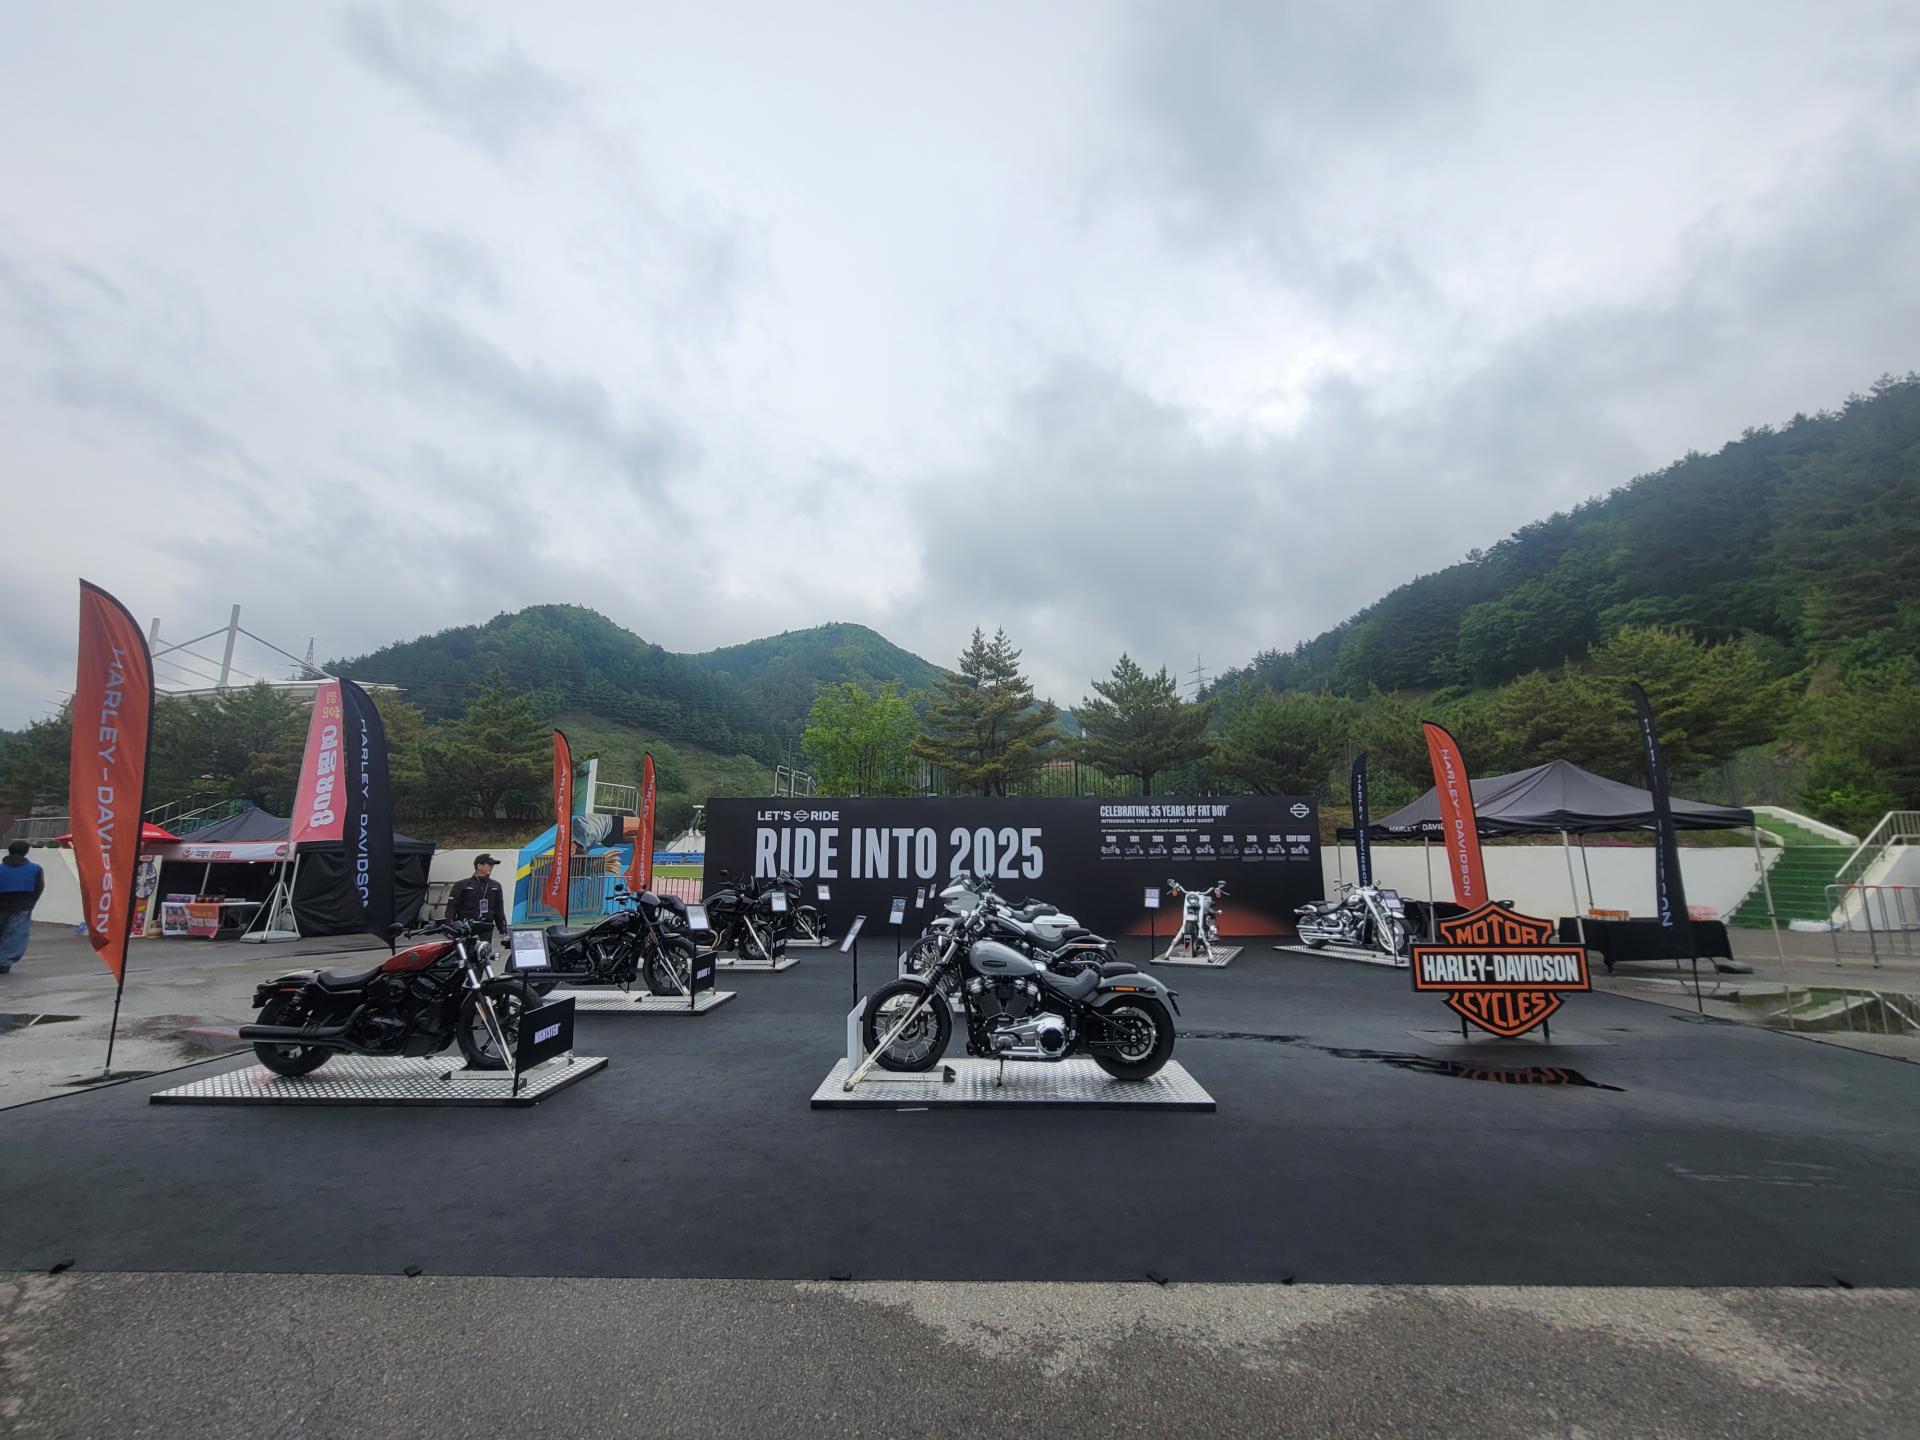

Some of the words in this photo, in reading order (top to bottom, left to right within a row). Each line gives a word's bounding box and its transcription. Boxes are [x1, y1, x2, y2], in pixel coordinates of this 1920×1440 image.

[757, 810, 792, 821] LET'S
[810, 810, 840, 821] RIDE
[1100, 805, 1150, 817] CELEBRATING
[1150, 805, 1161, 817] 35
[1162, 805, 1186, 817] YEARS
[1186, 805, 1197, 817] OF
[1198, 805, 1212, 817] FAT
[755, 827, 839, 879] RIDE
[850, 827, 937, 879] INTO
[949, 827, 1044, 880] 2025
[1455, 914, 1538, 945] MOTOR
[1422, 954, 1580, 982] HARLEY-DAVIDSON
[1463, 992, 1546, 1028] CYCLES
